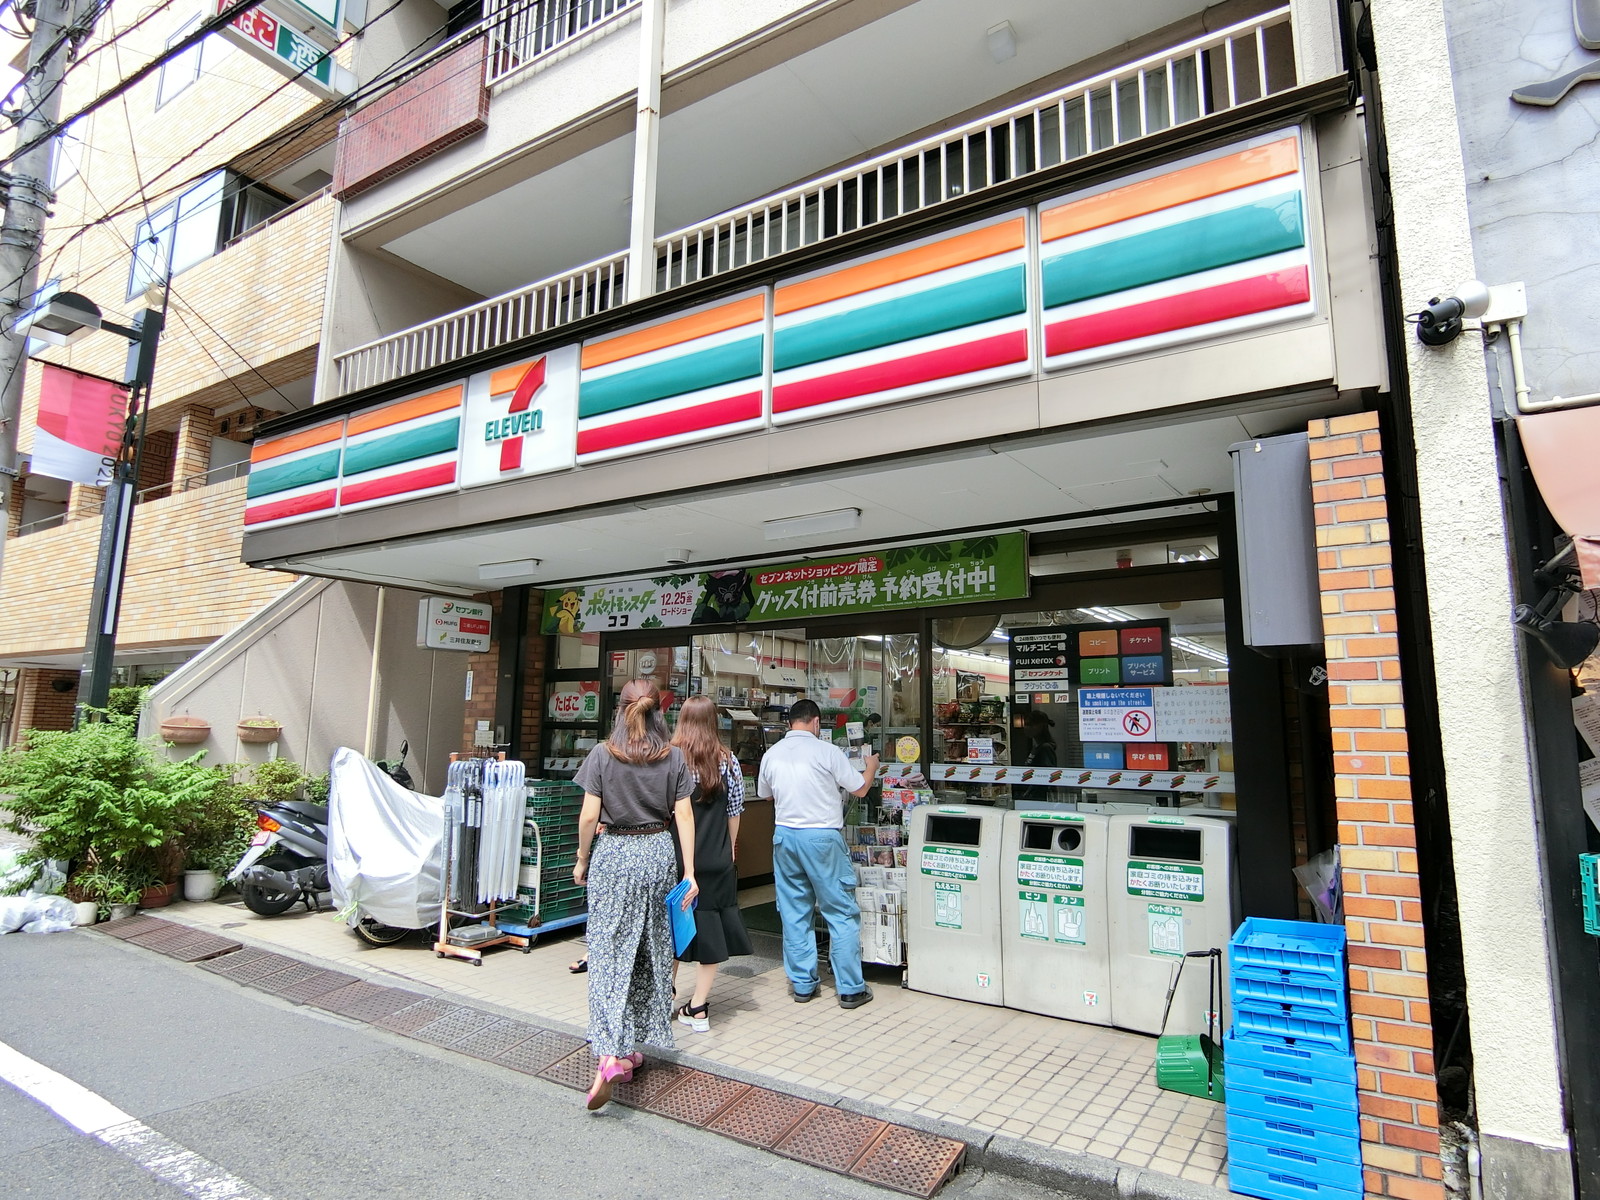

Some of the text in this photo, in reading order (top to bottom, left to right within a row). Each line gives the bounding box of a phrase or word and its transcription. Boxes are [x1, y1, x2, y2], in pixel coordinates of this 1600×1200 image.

[289, 33, 321, 76] 酒
[105, 384, 128, 442] OKYO
[760, 560, 877, 584] セブンネットショッピング限定
[585, 588, 657, 616] ポケットモンスター
[661, 592, 686, 606] 12.25
[455, 606, 484, 616] セブン銀行
[661, 608, 692, 616] ロードショー
[608, 614, 629, 627] ココ
[1015, 642, 1066, 652] マルチコピー機
[555, 695, 596, 712] たばこ 酒
[1061, 896, 1078, 905] カン
[1148, 904, 1183, 915] ペットボトル
